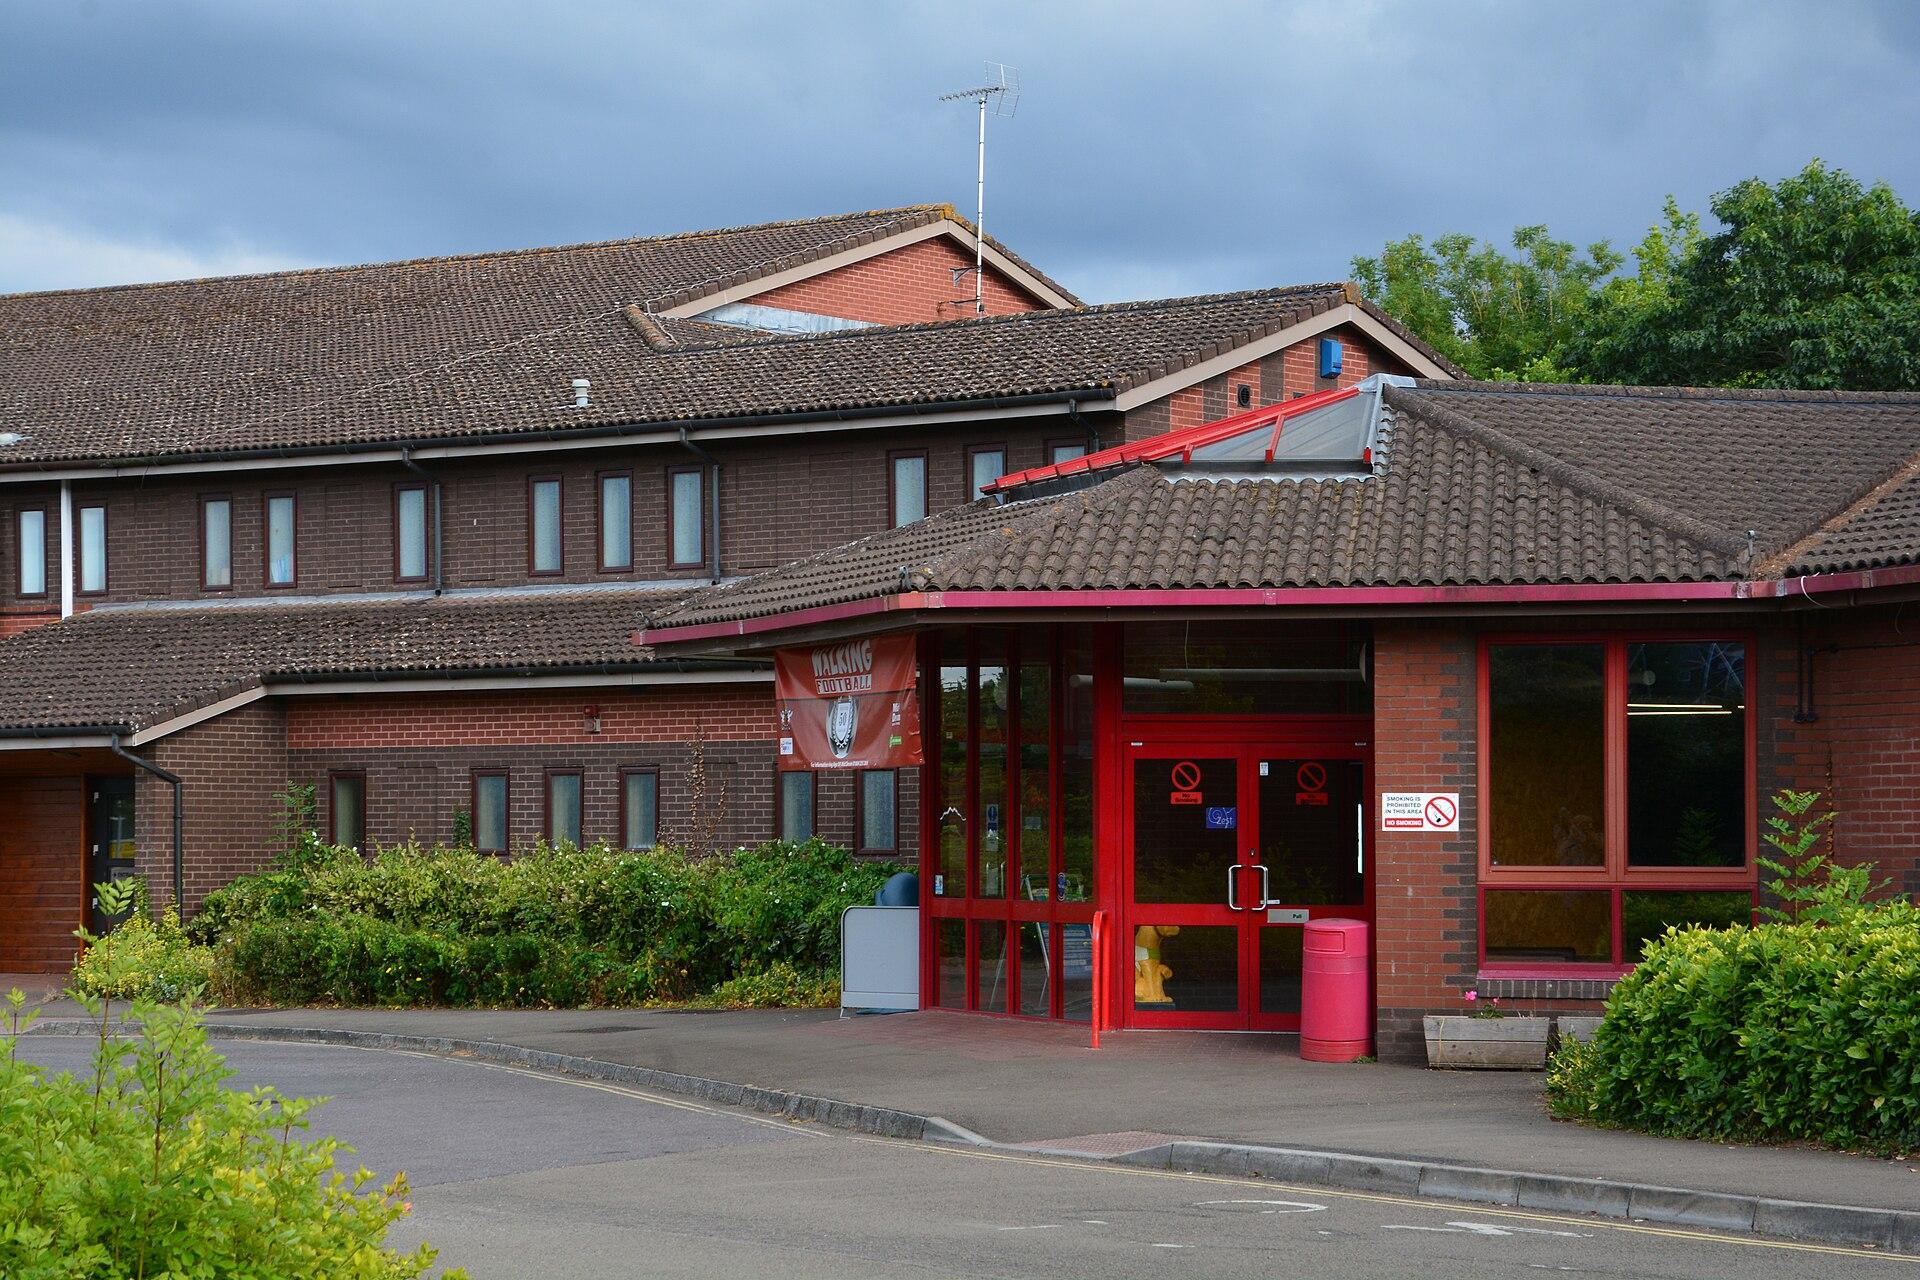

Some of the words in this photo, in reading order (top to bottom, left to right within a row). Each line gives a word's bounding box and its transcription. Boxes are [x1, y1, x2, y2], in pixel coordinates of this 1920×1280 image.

[811, 640, 872, 677] WALKING
[816, 675, 871, 693] FOOTBALL
[1216, 816, 1233, 827] Zest
